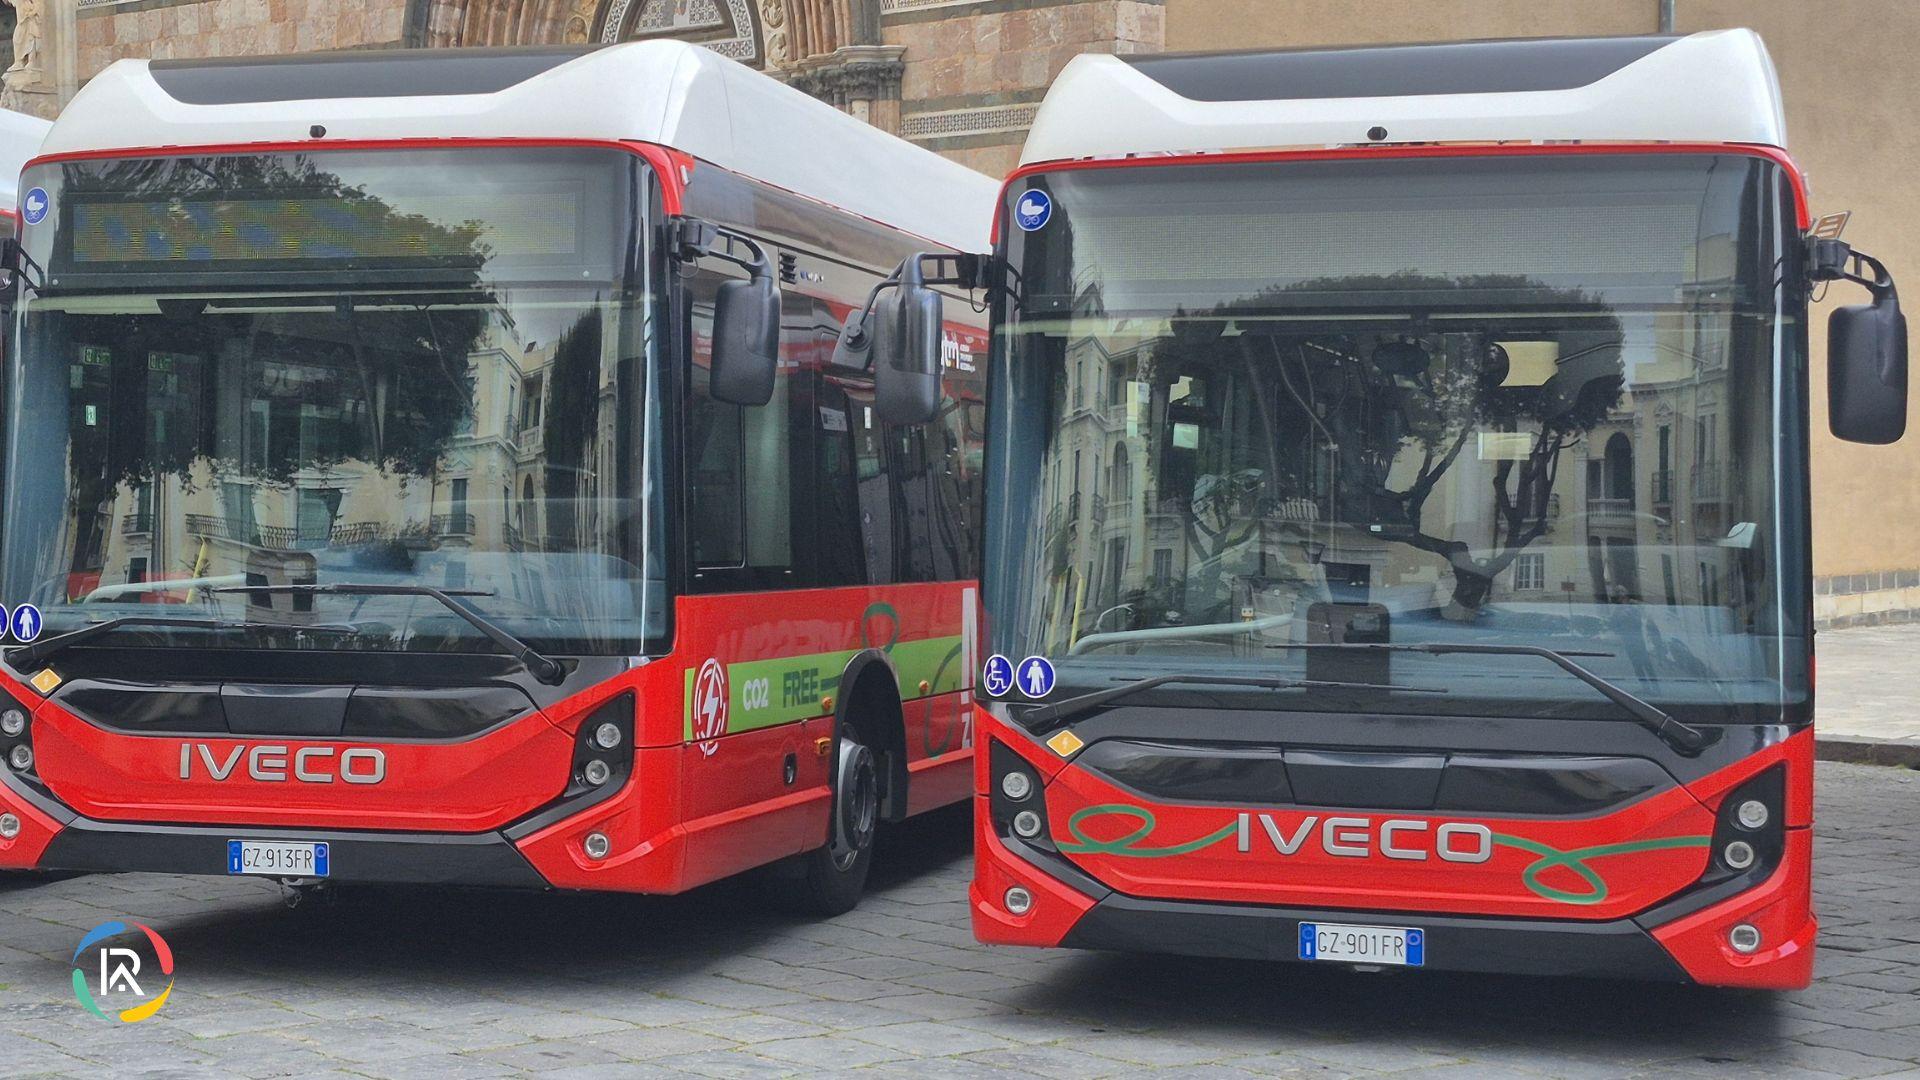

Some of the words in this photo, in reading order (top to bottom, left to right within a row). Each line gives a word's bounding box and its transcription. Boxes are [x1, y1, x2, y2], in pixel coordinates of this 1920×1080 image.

[743, 677, 769, 712] CO2
[782, 667, 819, 709] FREE
[179, 743, 385, 785] IVECO
[1237, 813, 1492, 863] IVECO
